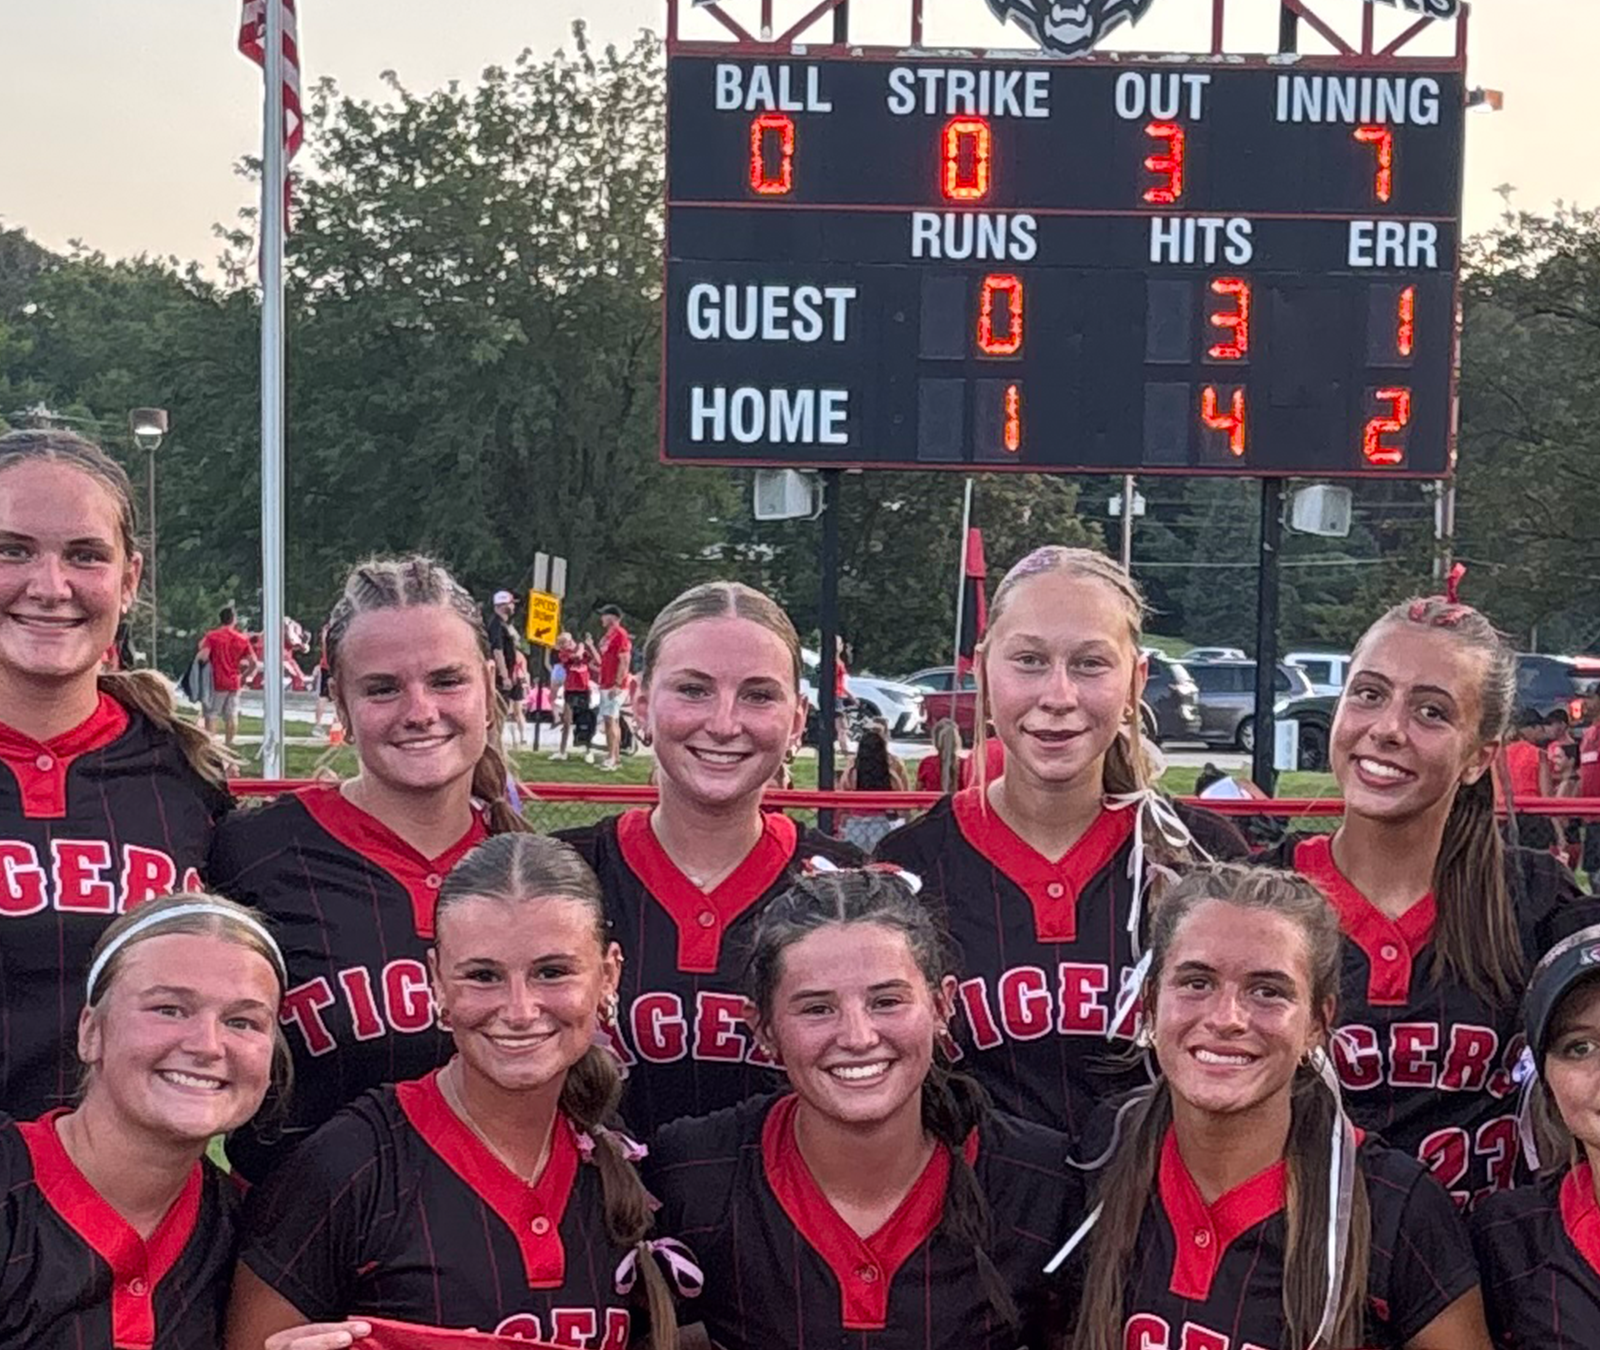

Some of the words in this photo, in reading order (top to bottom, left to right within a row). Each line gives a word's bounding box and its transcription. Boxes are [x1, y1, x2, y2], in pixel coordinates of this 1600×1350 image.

[715, 63, 832, 113] BALL
[887, 66, 1050, 118] STRIKE
[1114, 71, 1211, 120] OUT
[1275, 75, 1440, 126] INNING
[749, 113, 794, 195] 0
[941, 115, 992, 202] 0
[1144, 121, 1185, 204] 3
[1353, 125, 1393, 202] 7
[911, 211, 1038, 261] RUNS
[1149, 216, 1254, 266] HITS
[1347, 220, 1439, 269] ERR
[686, 283, 857, 342] GUEST
[976, 273, 1023, 356] 0
[1209, 276, 1250, 360] 3
[1397, 285, 1415, 356] 1
[690, 386, 850, 445] HOME
[1004, 384, 1020, 452] 1
[1200, 388, 1246, 457] 4
[1362, 387, 1411, 465] 2
[1417, 1115, 1522, 1213] 23
